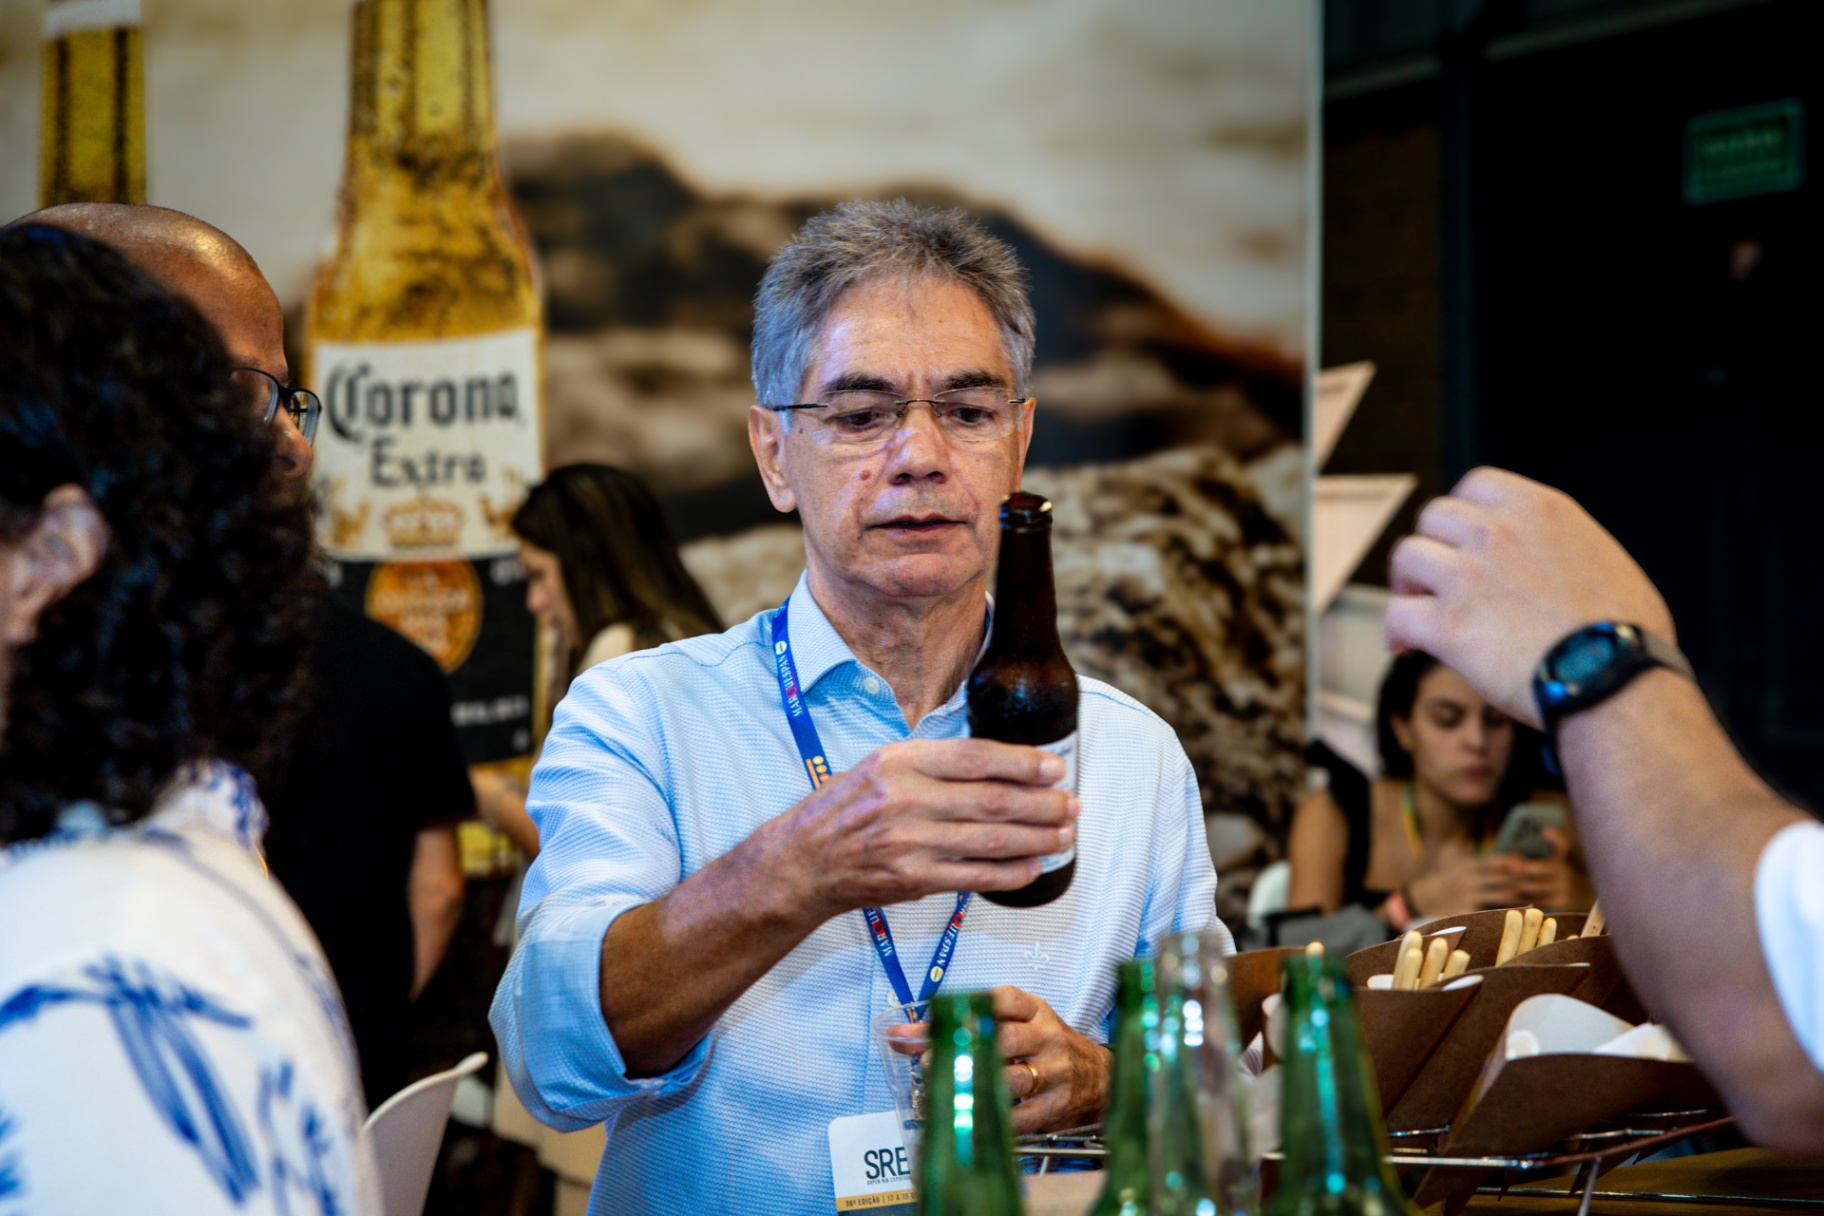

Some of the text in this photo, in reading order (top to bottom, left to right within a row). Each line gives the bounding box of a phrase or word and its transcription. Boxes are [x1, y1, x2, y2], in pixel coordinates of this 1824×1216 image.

[326, 363, 521, 442] Corona
[370, 437, 487, 487] Extra
[777, 653, 804, 718] MARQUESPAN
[867, 907, 895, 958] MARQUE
[936, 904, 967, 967] QUESPAN
[863, 1146, 911, 1180] SRE
[887, 1194, 894, 1202] 17
